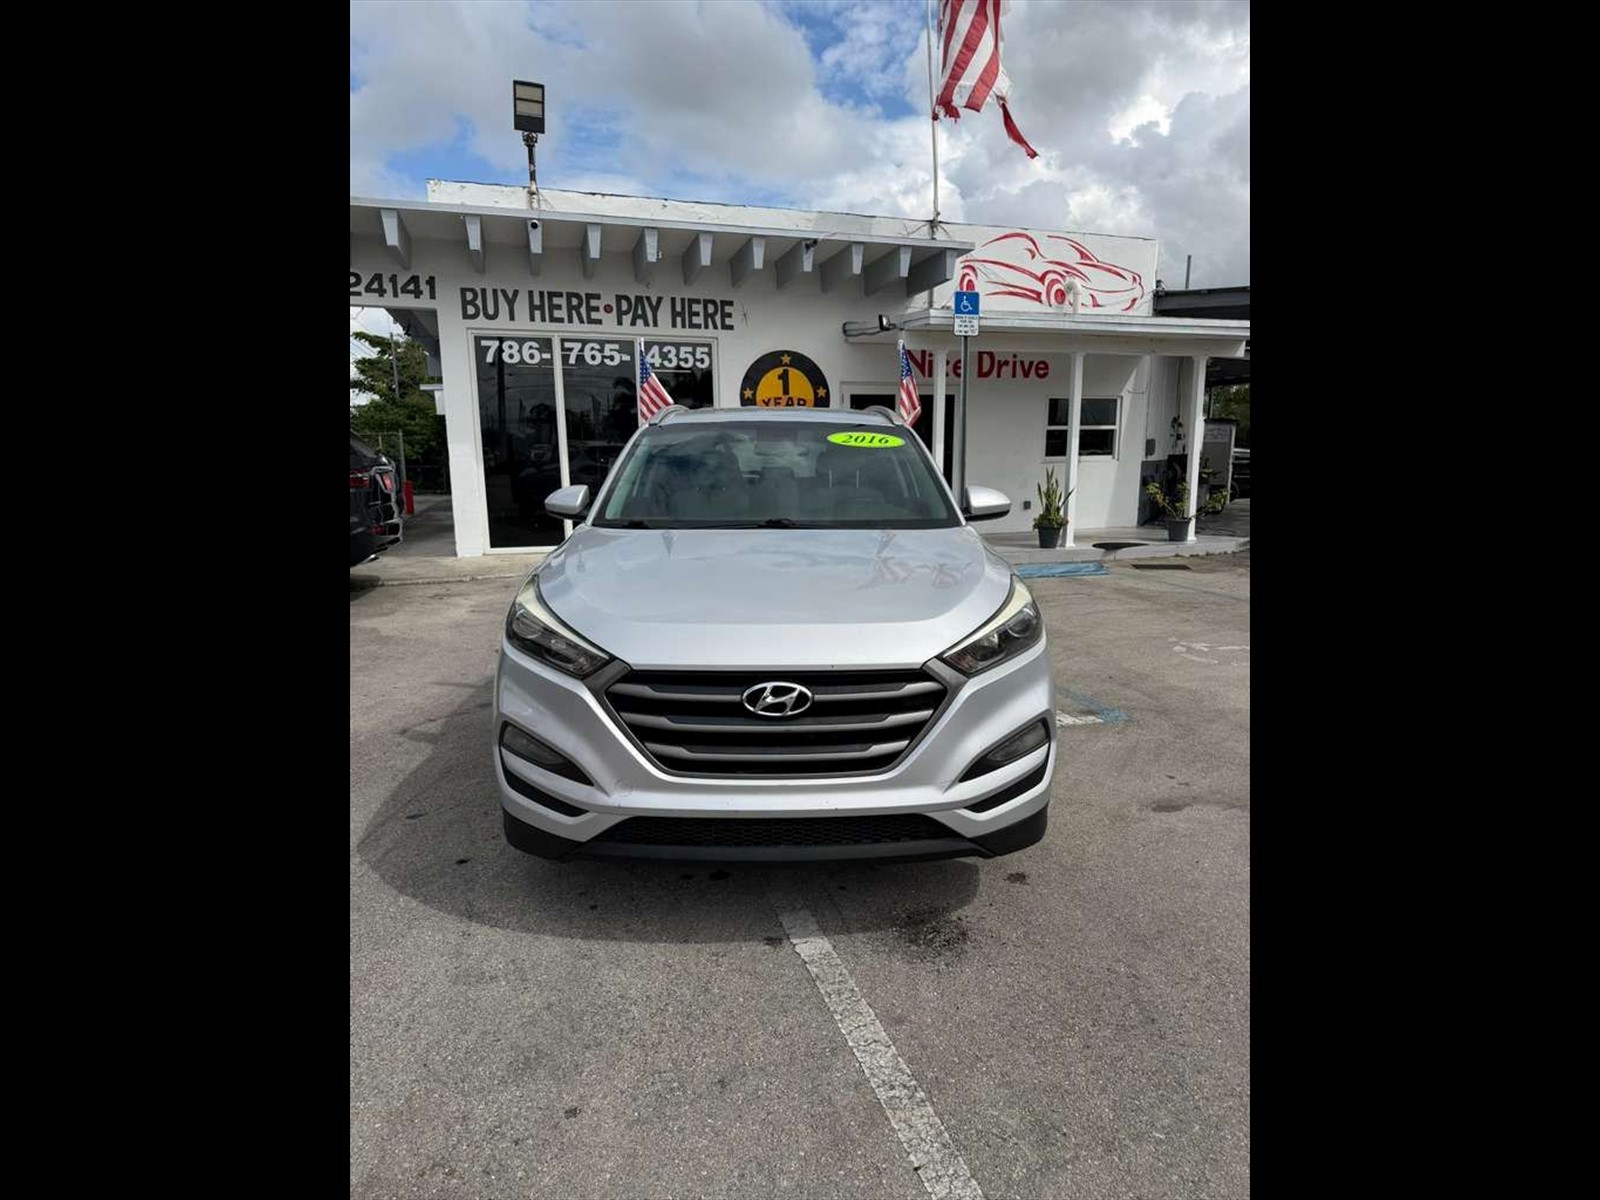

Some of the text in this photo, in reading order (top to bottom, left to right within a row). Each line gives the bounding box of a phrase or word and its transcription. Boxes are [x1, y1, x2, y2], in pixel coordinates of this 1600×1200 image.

[350, 272, 436, 300] 24141
[460, 287, 735, 331] BUY HERE PAY HERE
[480, 339, 710, 369] 786- 765- 4355
[907, 350, 1050, 379] Nie Drive
[777, 368, 790, 396] 1
[841, 434, 889, 444] 2016
